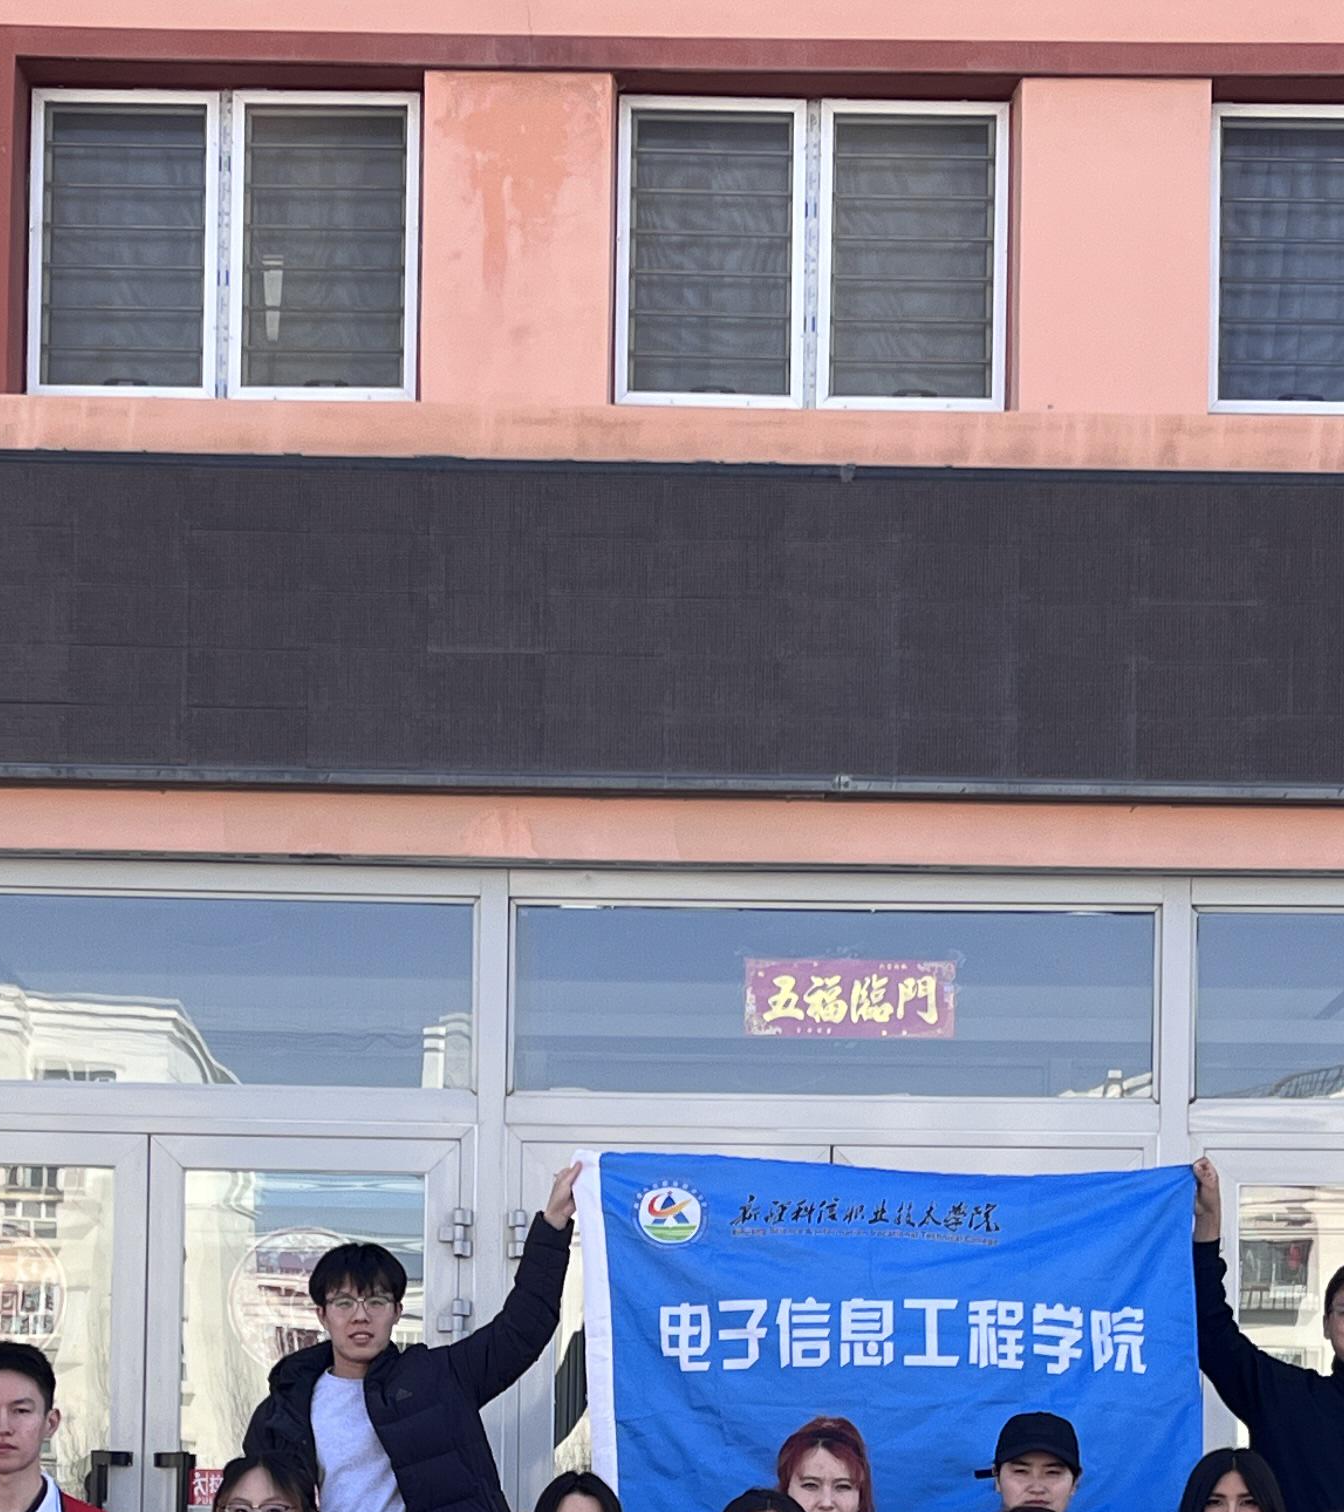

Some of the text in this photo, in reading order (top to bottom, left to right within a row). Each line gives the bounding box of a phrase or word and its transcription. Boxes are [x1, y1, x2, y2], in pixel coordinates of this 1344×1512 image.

[659, 1296, 1147, 1375] 电子信息工程学院
